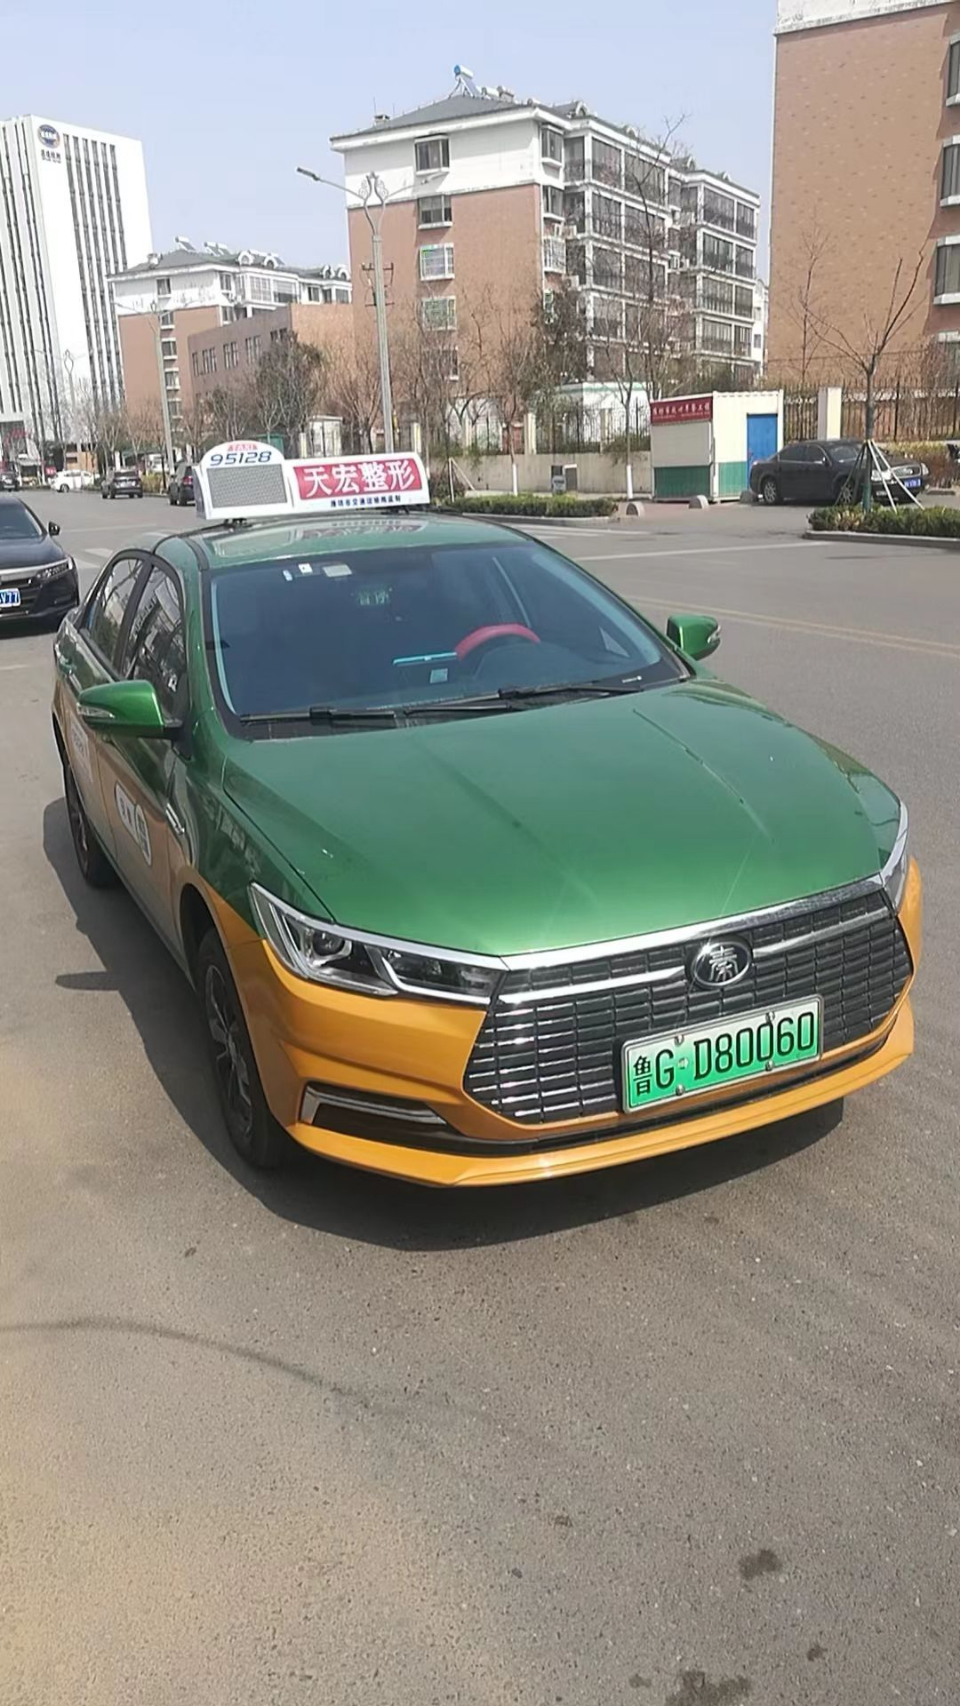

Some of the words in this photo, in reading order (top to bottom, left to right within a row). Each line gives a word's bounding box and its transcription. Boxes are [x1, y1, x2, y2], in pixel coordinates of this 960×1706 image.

[210, 451, 272, 466] 95128
[304, 460, 415, 498] 天宏整形
[709, 945, 738, 982] 秦
